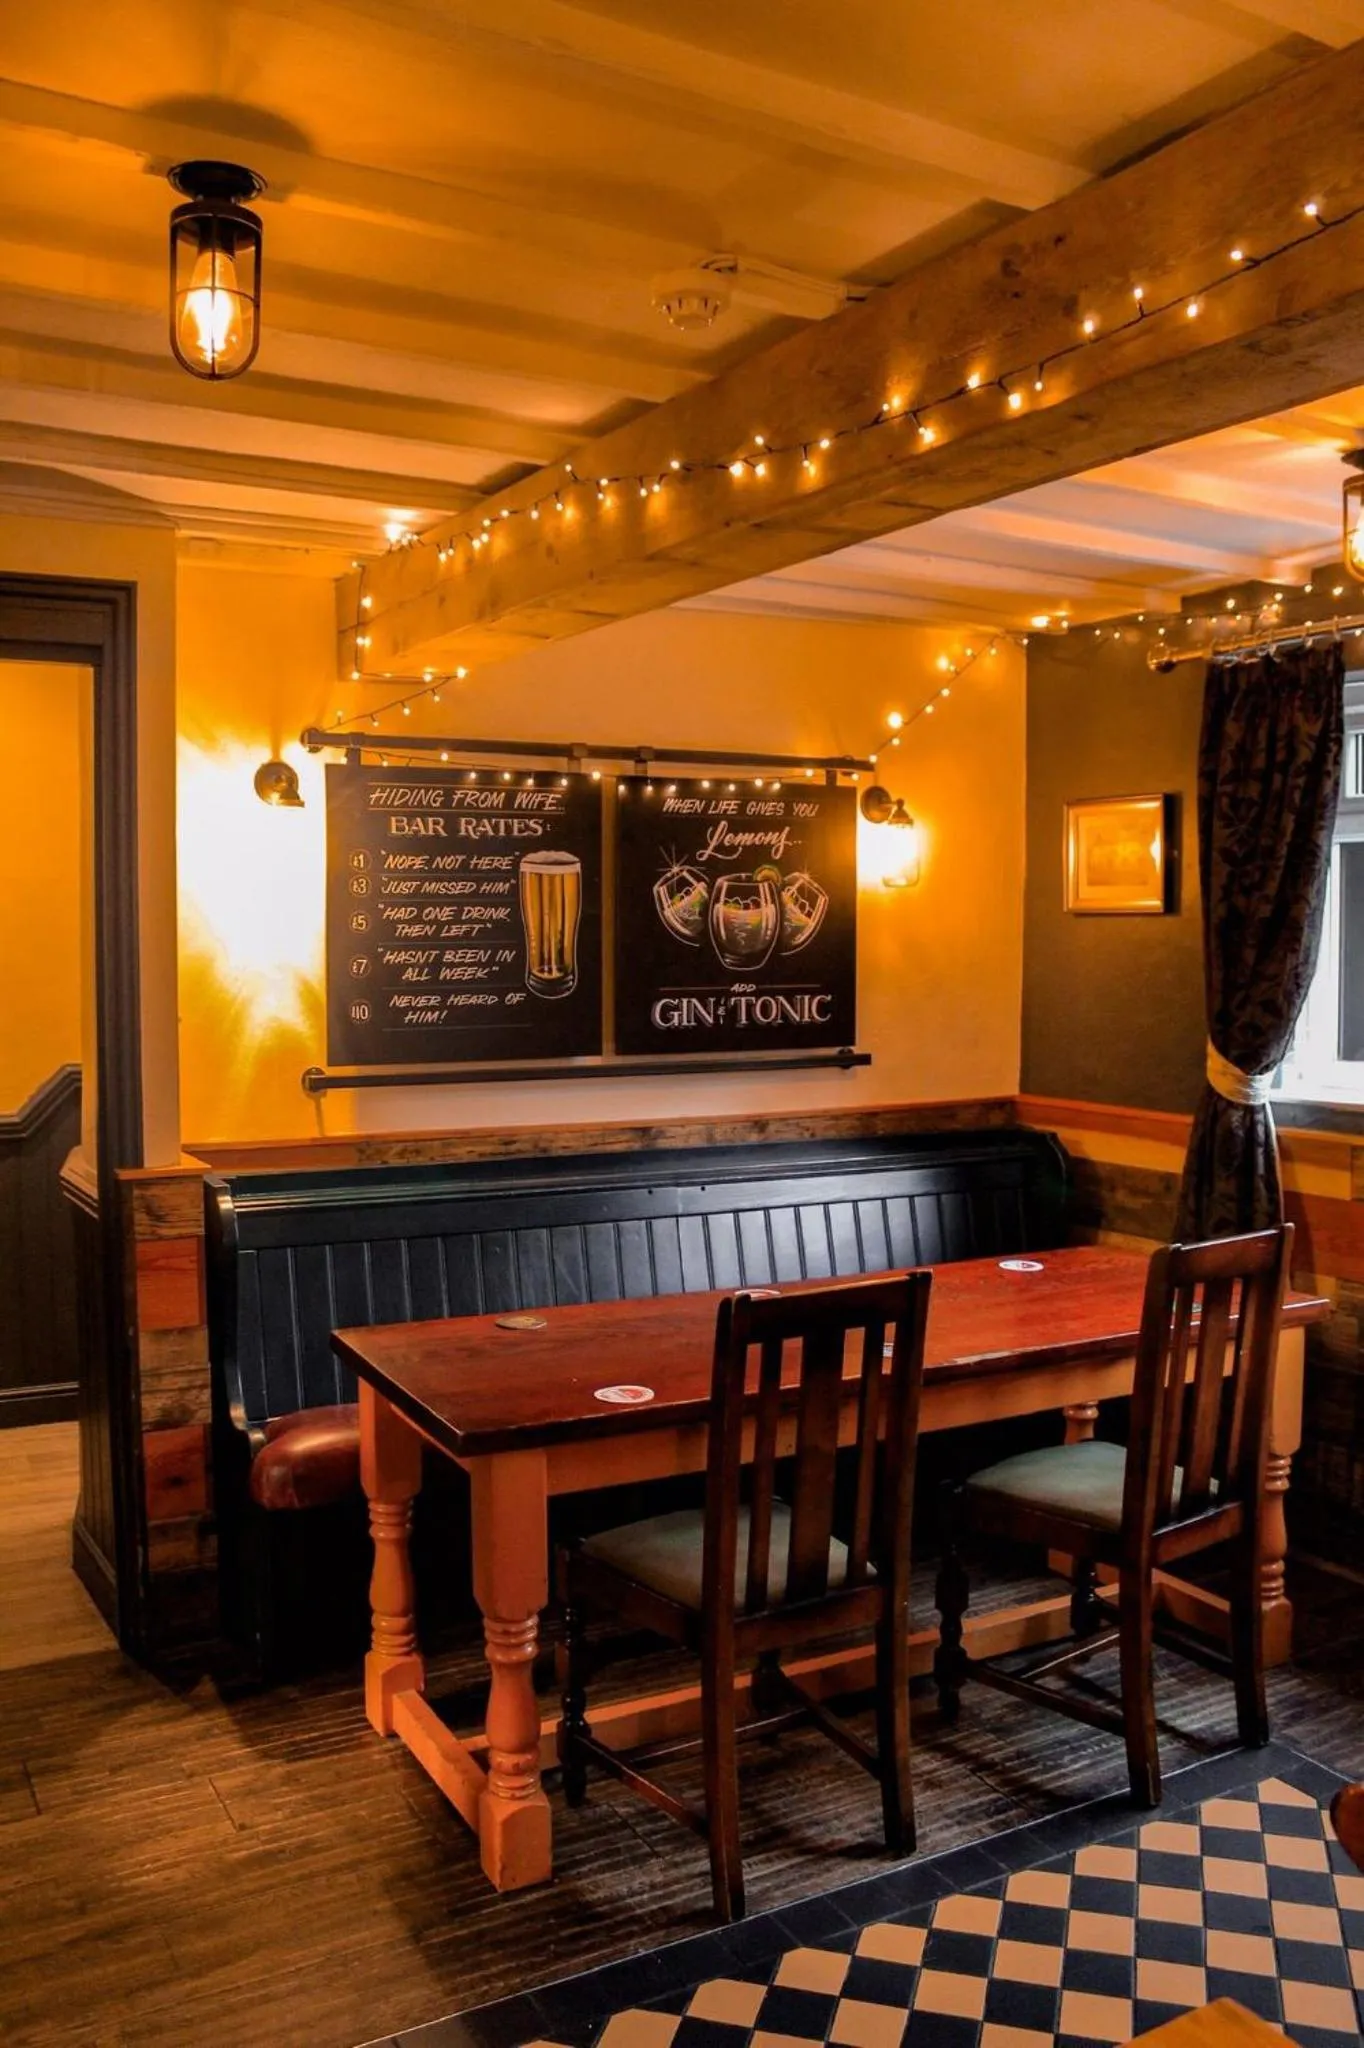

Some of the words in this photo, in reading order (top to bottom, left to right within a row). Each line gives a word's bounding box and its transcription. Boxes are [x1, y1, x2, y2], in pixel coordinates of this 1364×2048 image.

[369, 787, 444, 807] HIDING
[452, 790, 505, 808] FROM
[662, 798, 706, 813] WHEN
[708, 800, 741, 815] LIFE
[746, 802, 785, 816] GIVES
[792, 803, 820, 817] YOU
[390, 816, 448, 837] BAR
[432, 854, 463, 869] NOT
[421, 880, 477, 895] MISSED
[422, 907, 458, 921] ONE
[395, 924, 435, 937] THEN
[443, 950, 491, 963] BEEN
[496, 950, 516, 963] IN
[402, 967, 432, 981] ALL
[730, 983, 756, 992] ADD
[389, 994, 441, 1008] NEVER
[447, 994, 500, 1007] HEARD
[504, 992, 527, 1006] OF
[404, 1010, 449, 1024] HIM!
[652, 997, 716, 1028] GIN
[730, 994, 832, 1025] TONIC
